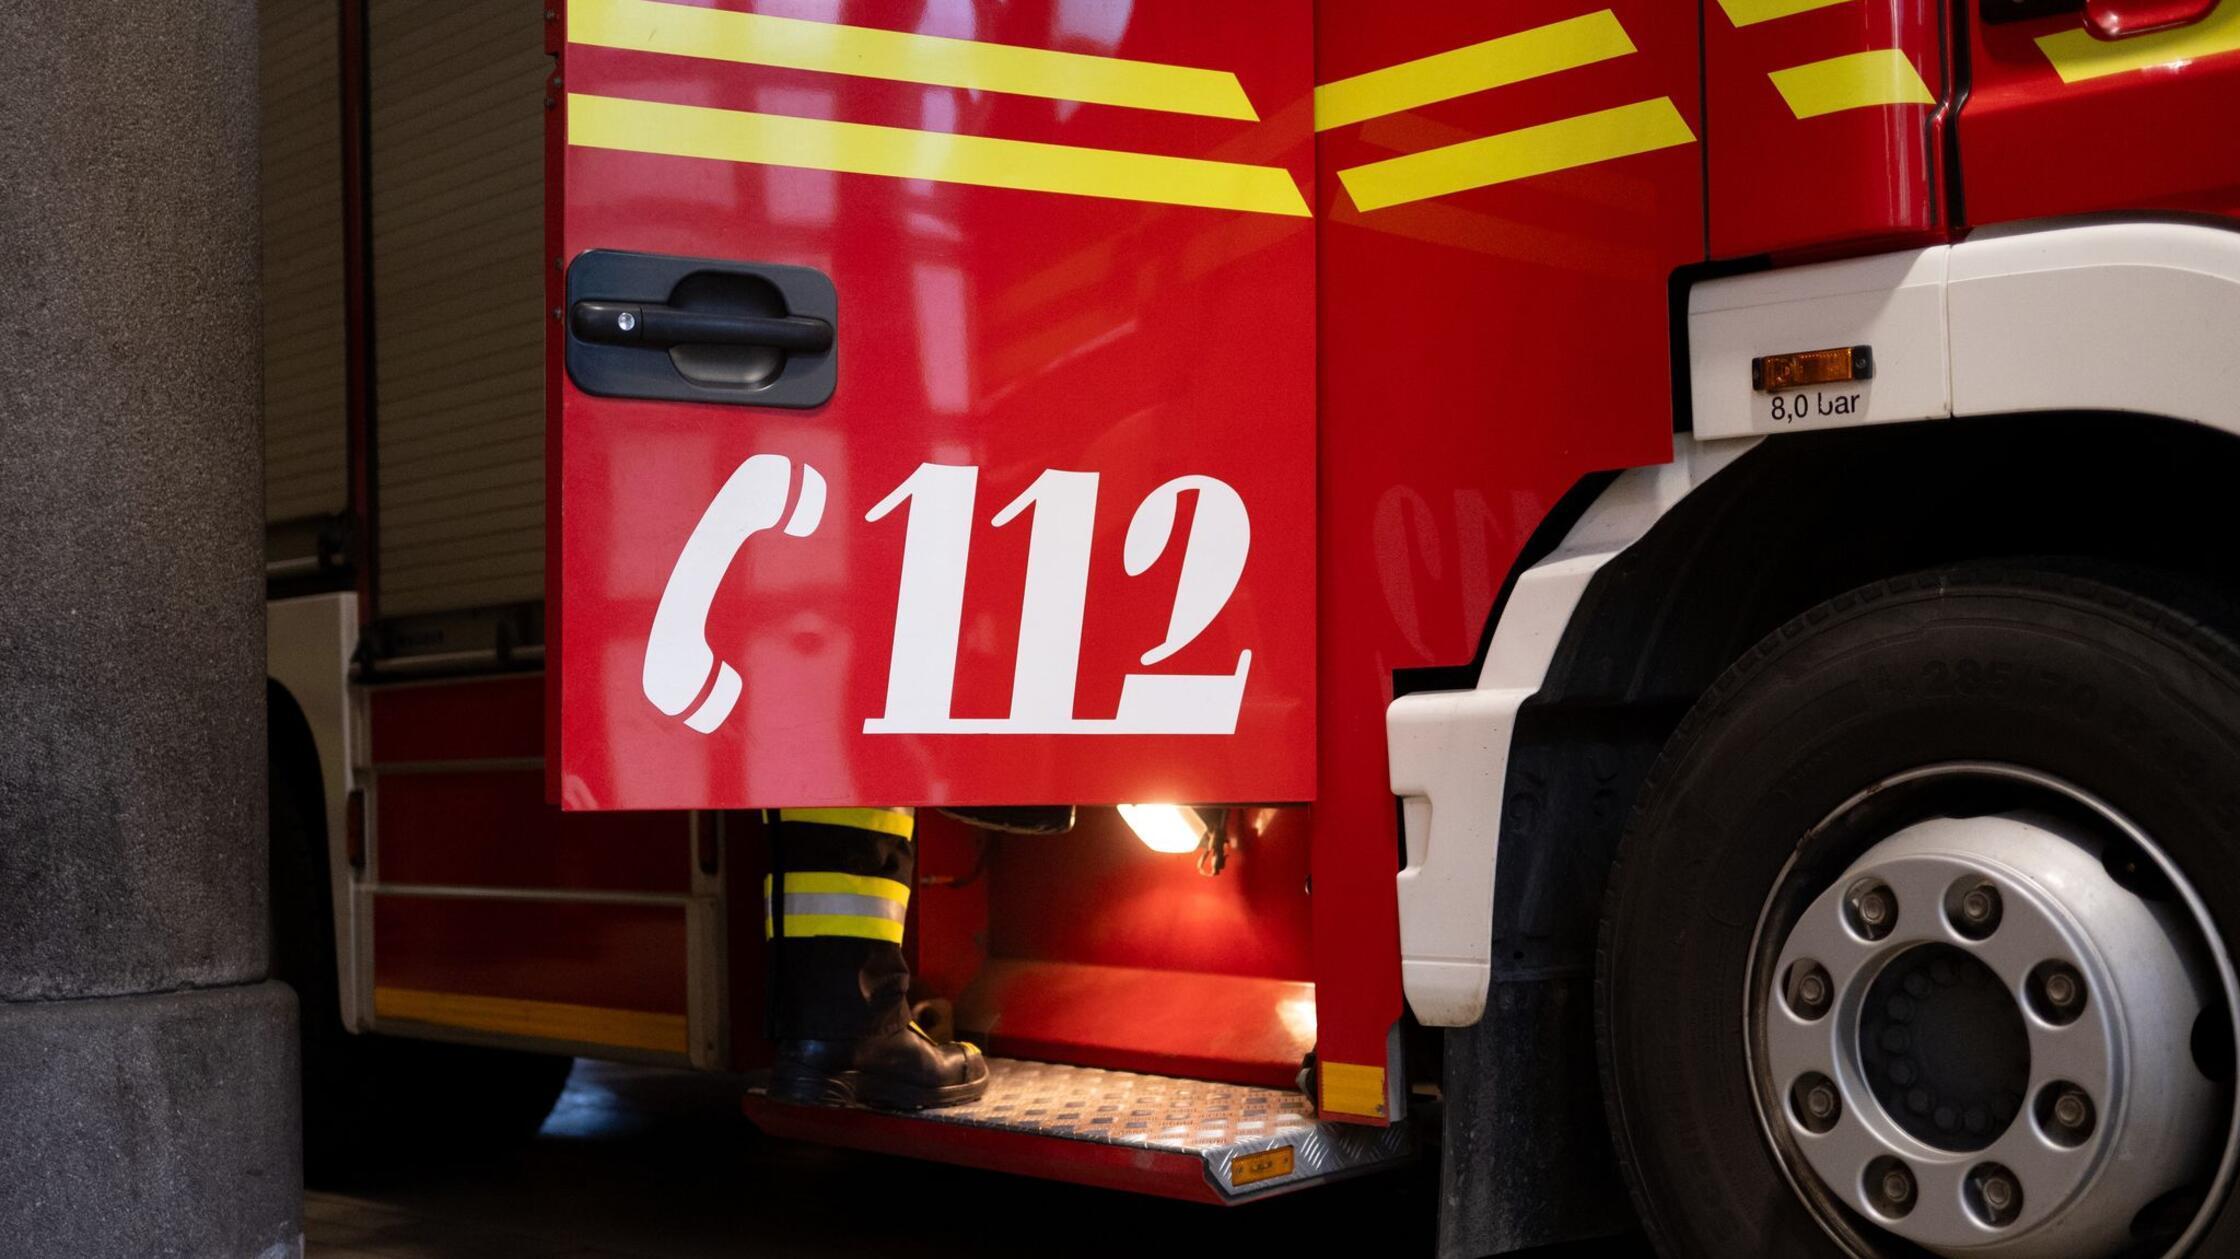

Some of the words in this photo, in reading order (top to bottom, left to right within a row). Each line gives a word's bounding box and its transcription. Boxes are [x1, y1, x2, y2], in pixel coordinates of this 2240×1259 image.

[1771, 393, 1808, 424] 8,0
[1817, 391, 1860, 416] bar
[862, 462, 1252, 735] 112
